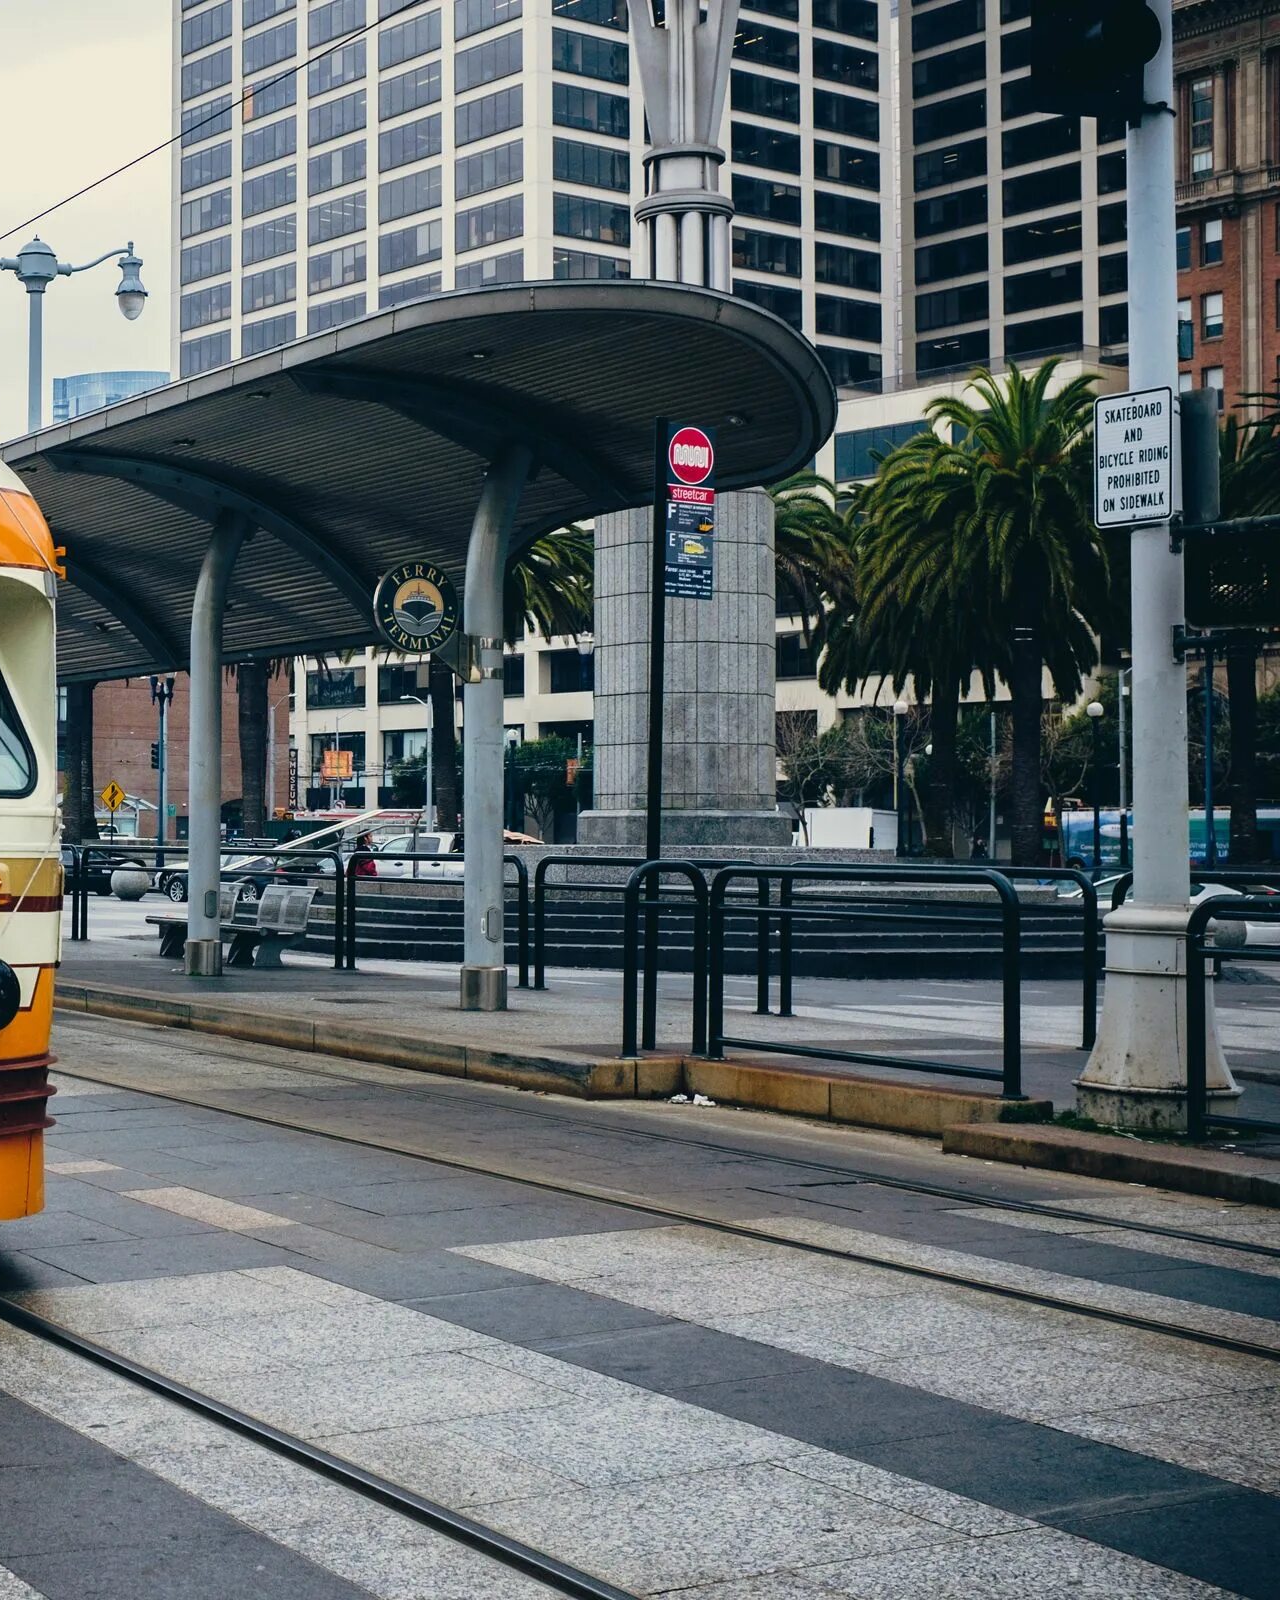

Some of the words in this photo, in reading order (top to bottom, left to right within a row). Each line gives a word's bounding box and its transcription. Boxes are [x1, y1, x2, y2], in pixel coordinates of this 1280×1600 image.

[1104, 401, 1162, 424] SKATEBOARD
[1123, 427, 1143, 443] AND
[1099, 450, 1134, 469] BICYCLE
[1139, 445, 1168, 463] RIDING
[1107, 469, 1160, 490] PROHIBITED
[672, 487, 708, 501] streetcar
[1103, 498, 1115, 513] ON
[1120, 491, 1164, 511] SIDEWALK
[668, 503, 677, 518] F
[669, 532, 676, 547] E
[392, 564, 448, 587] FERRY
[384, 612, 455, 649] TERMINAL
